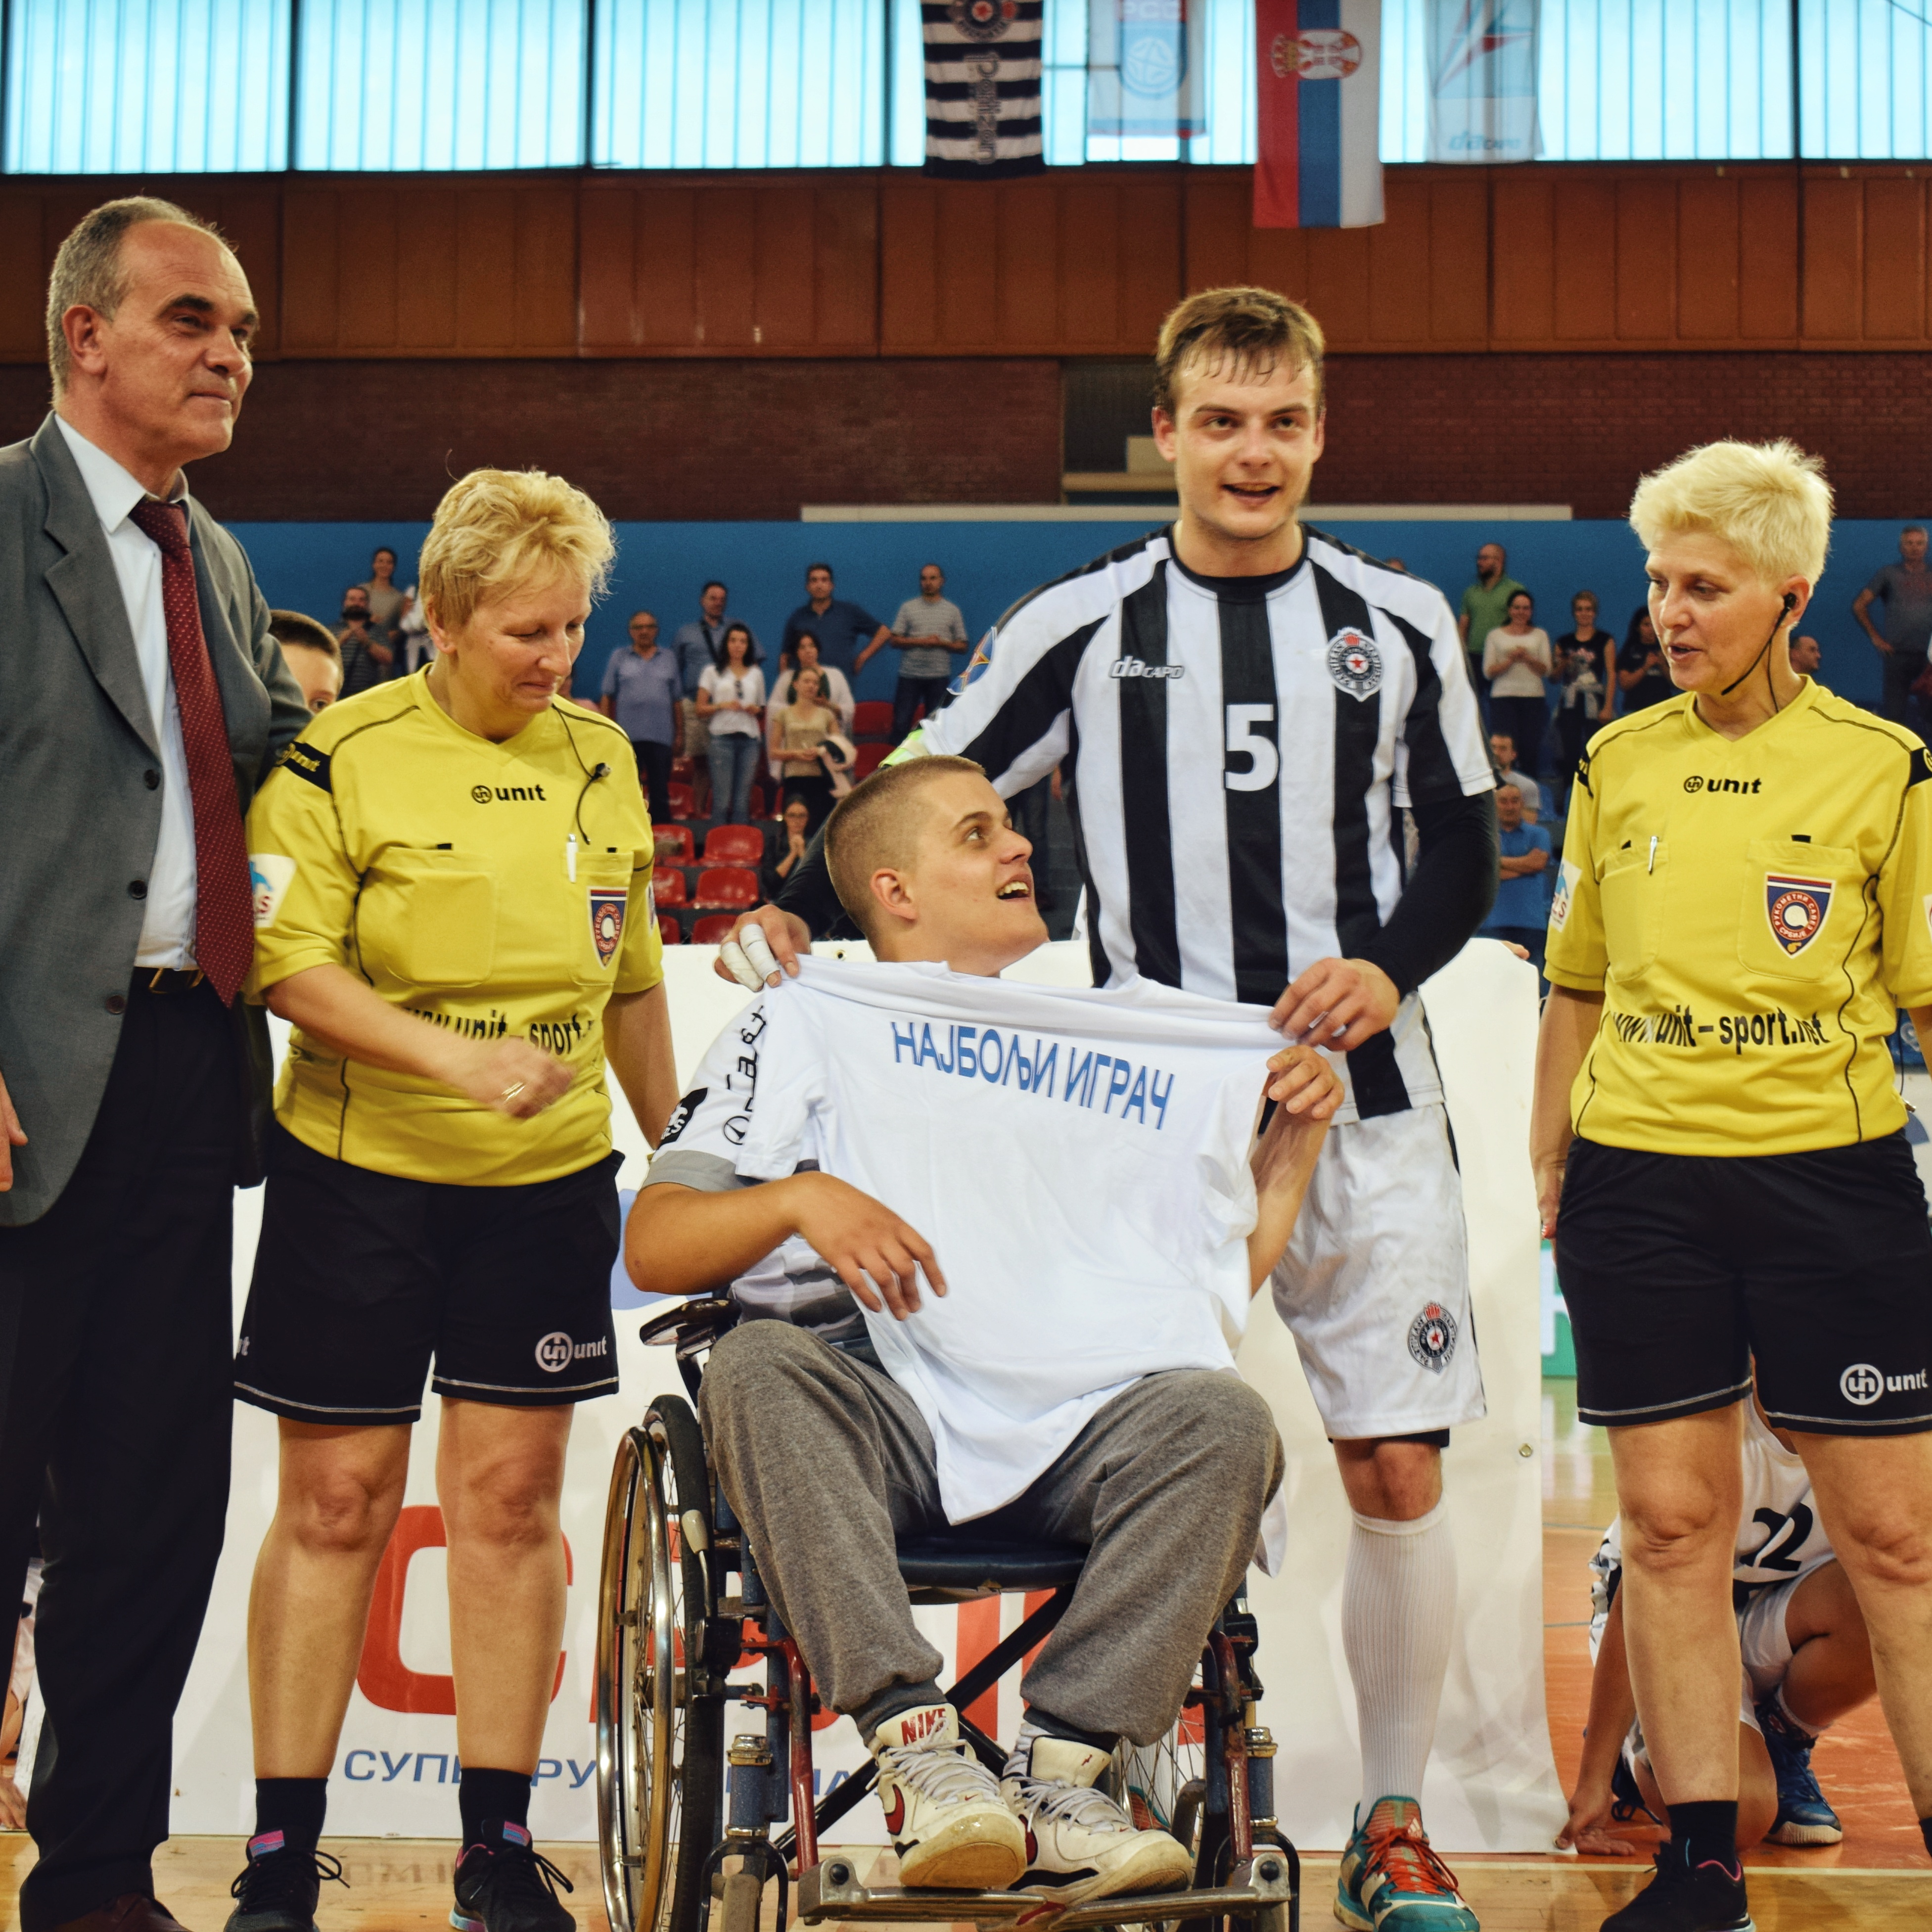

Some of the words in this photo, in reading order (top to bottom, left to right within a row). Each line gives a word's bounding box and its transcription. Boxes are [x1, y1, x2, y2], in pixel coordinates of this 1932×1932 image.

[1226, 703, 1279, 791] 5
[495, 784, 546, 801] unit
[1707, 778, 1761, 794] unit
[890, 1021, 1058, 1098] НАЈБОЉИ
[1063, 1046, 1174, 1130] ИГРАЧ
[574, 1335, 607, 1359] unit
[1886, 1368, 1928, 1392] unit
